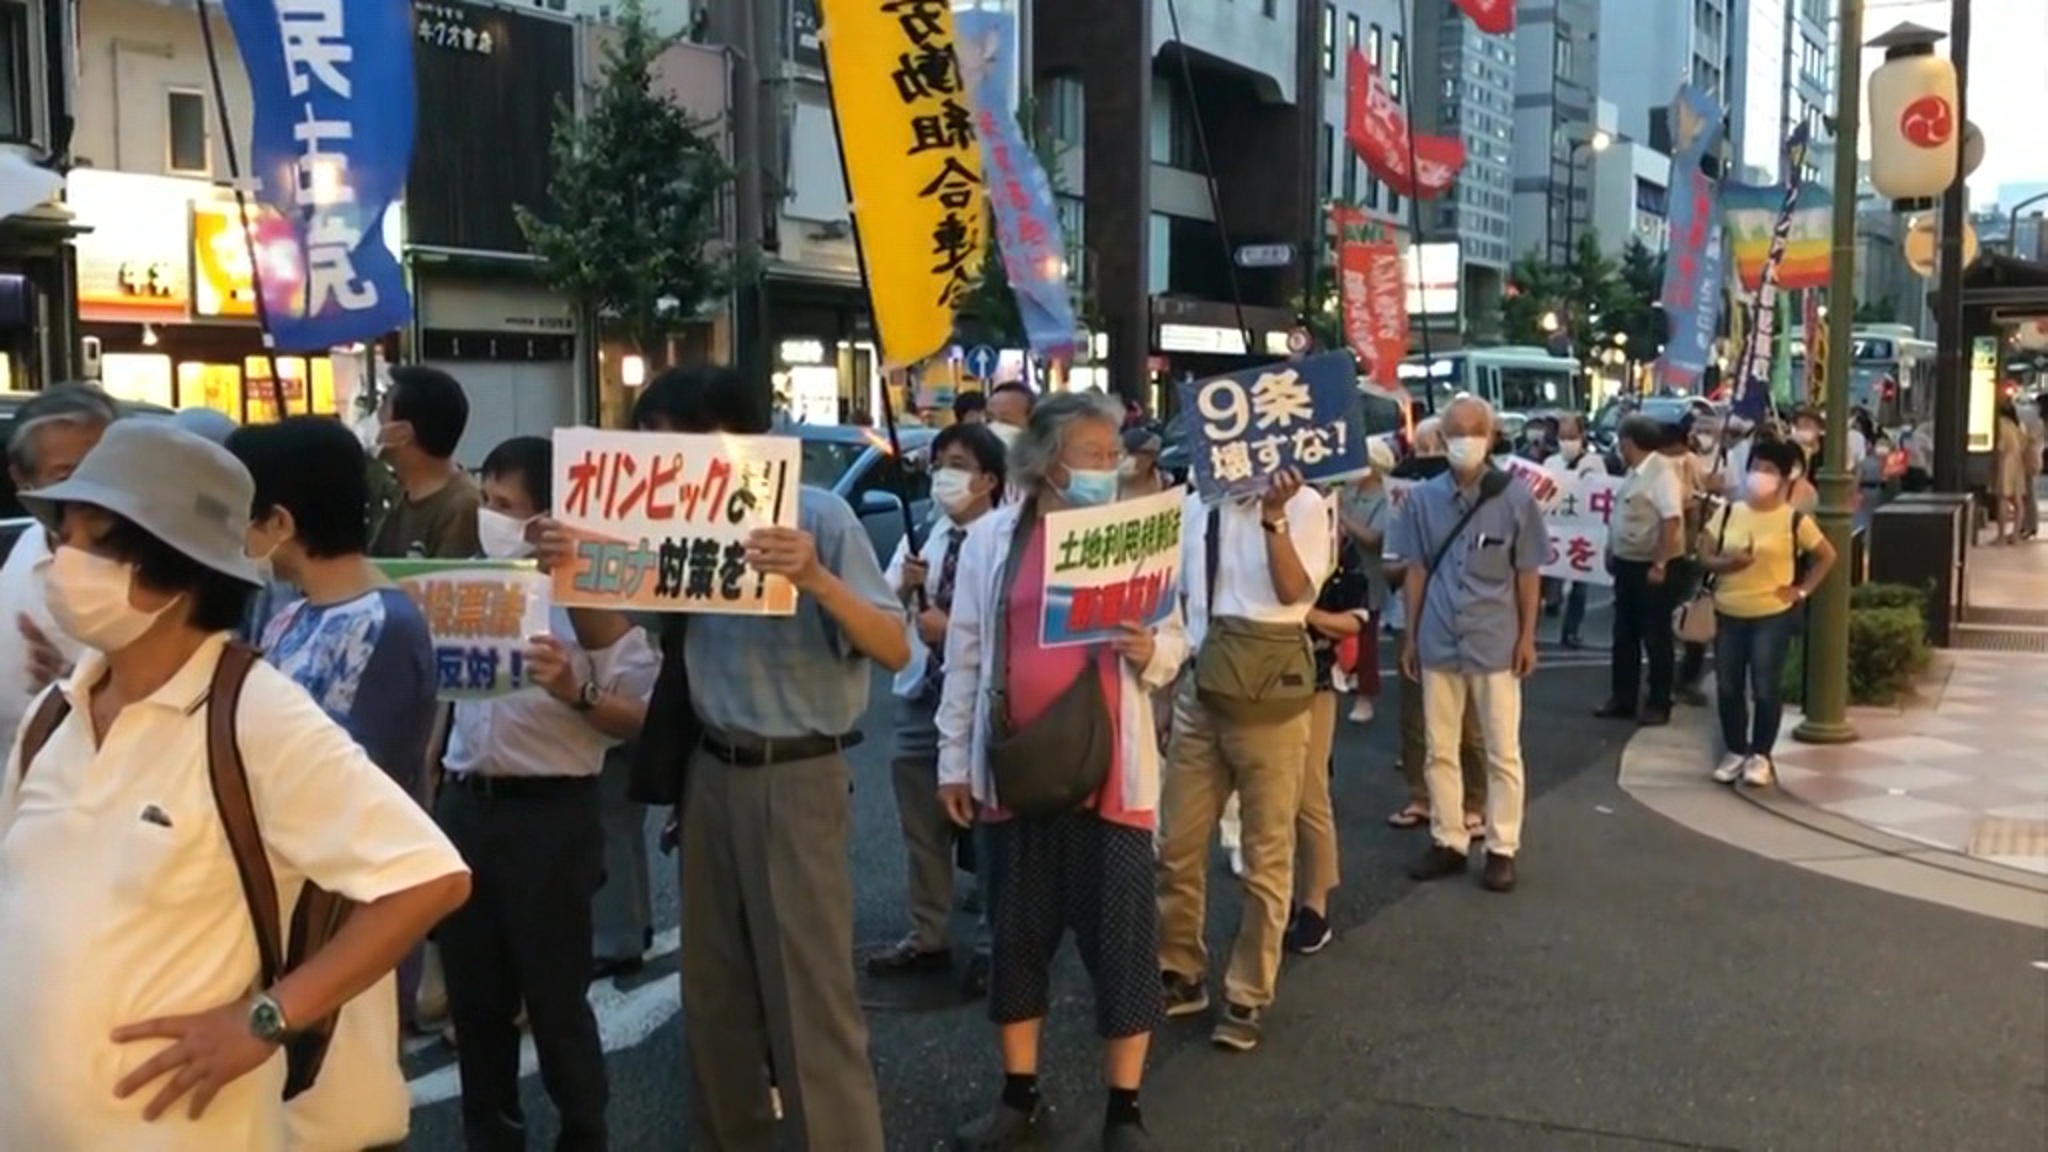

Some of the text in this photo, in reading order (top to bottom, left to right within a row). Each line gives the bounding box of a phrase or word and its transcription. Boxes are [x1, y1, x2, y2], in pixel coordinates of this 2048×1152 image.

[1197, 368, 1314, 441] 9条
[1211, 421, 1347, 481] 壊すな!
[405, 579, 526, 639] 投票法
